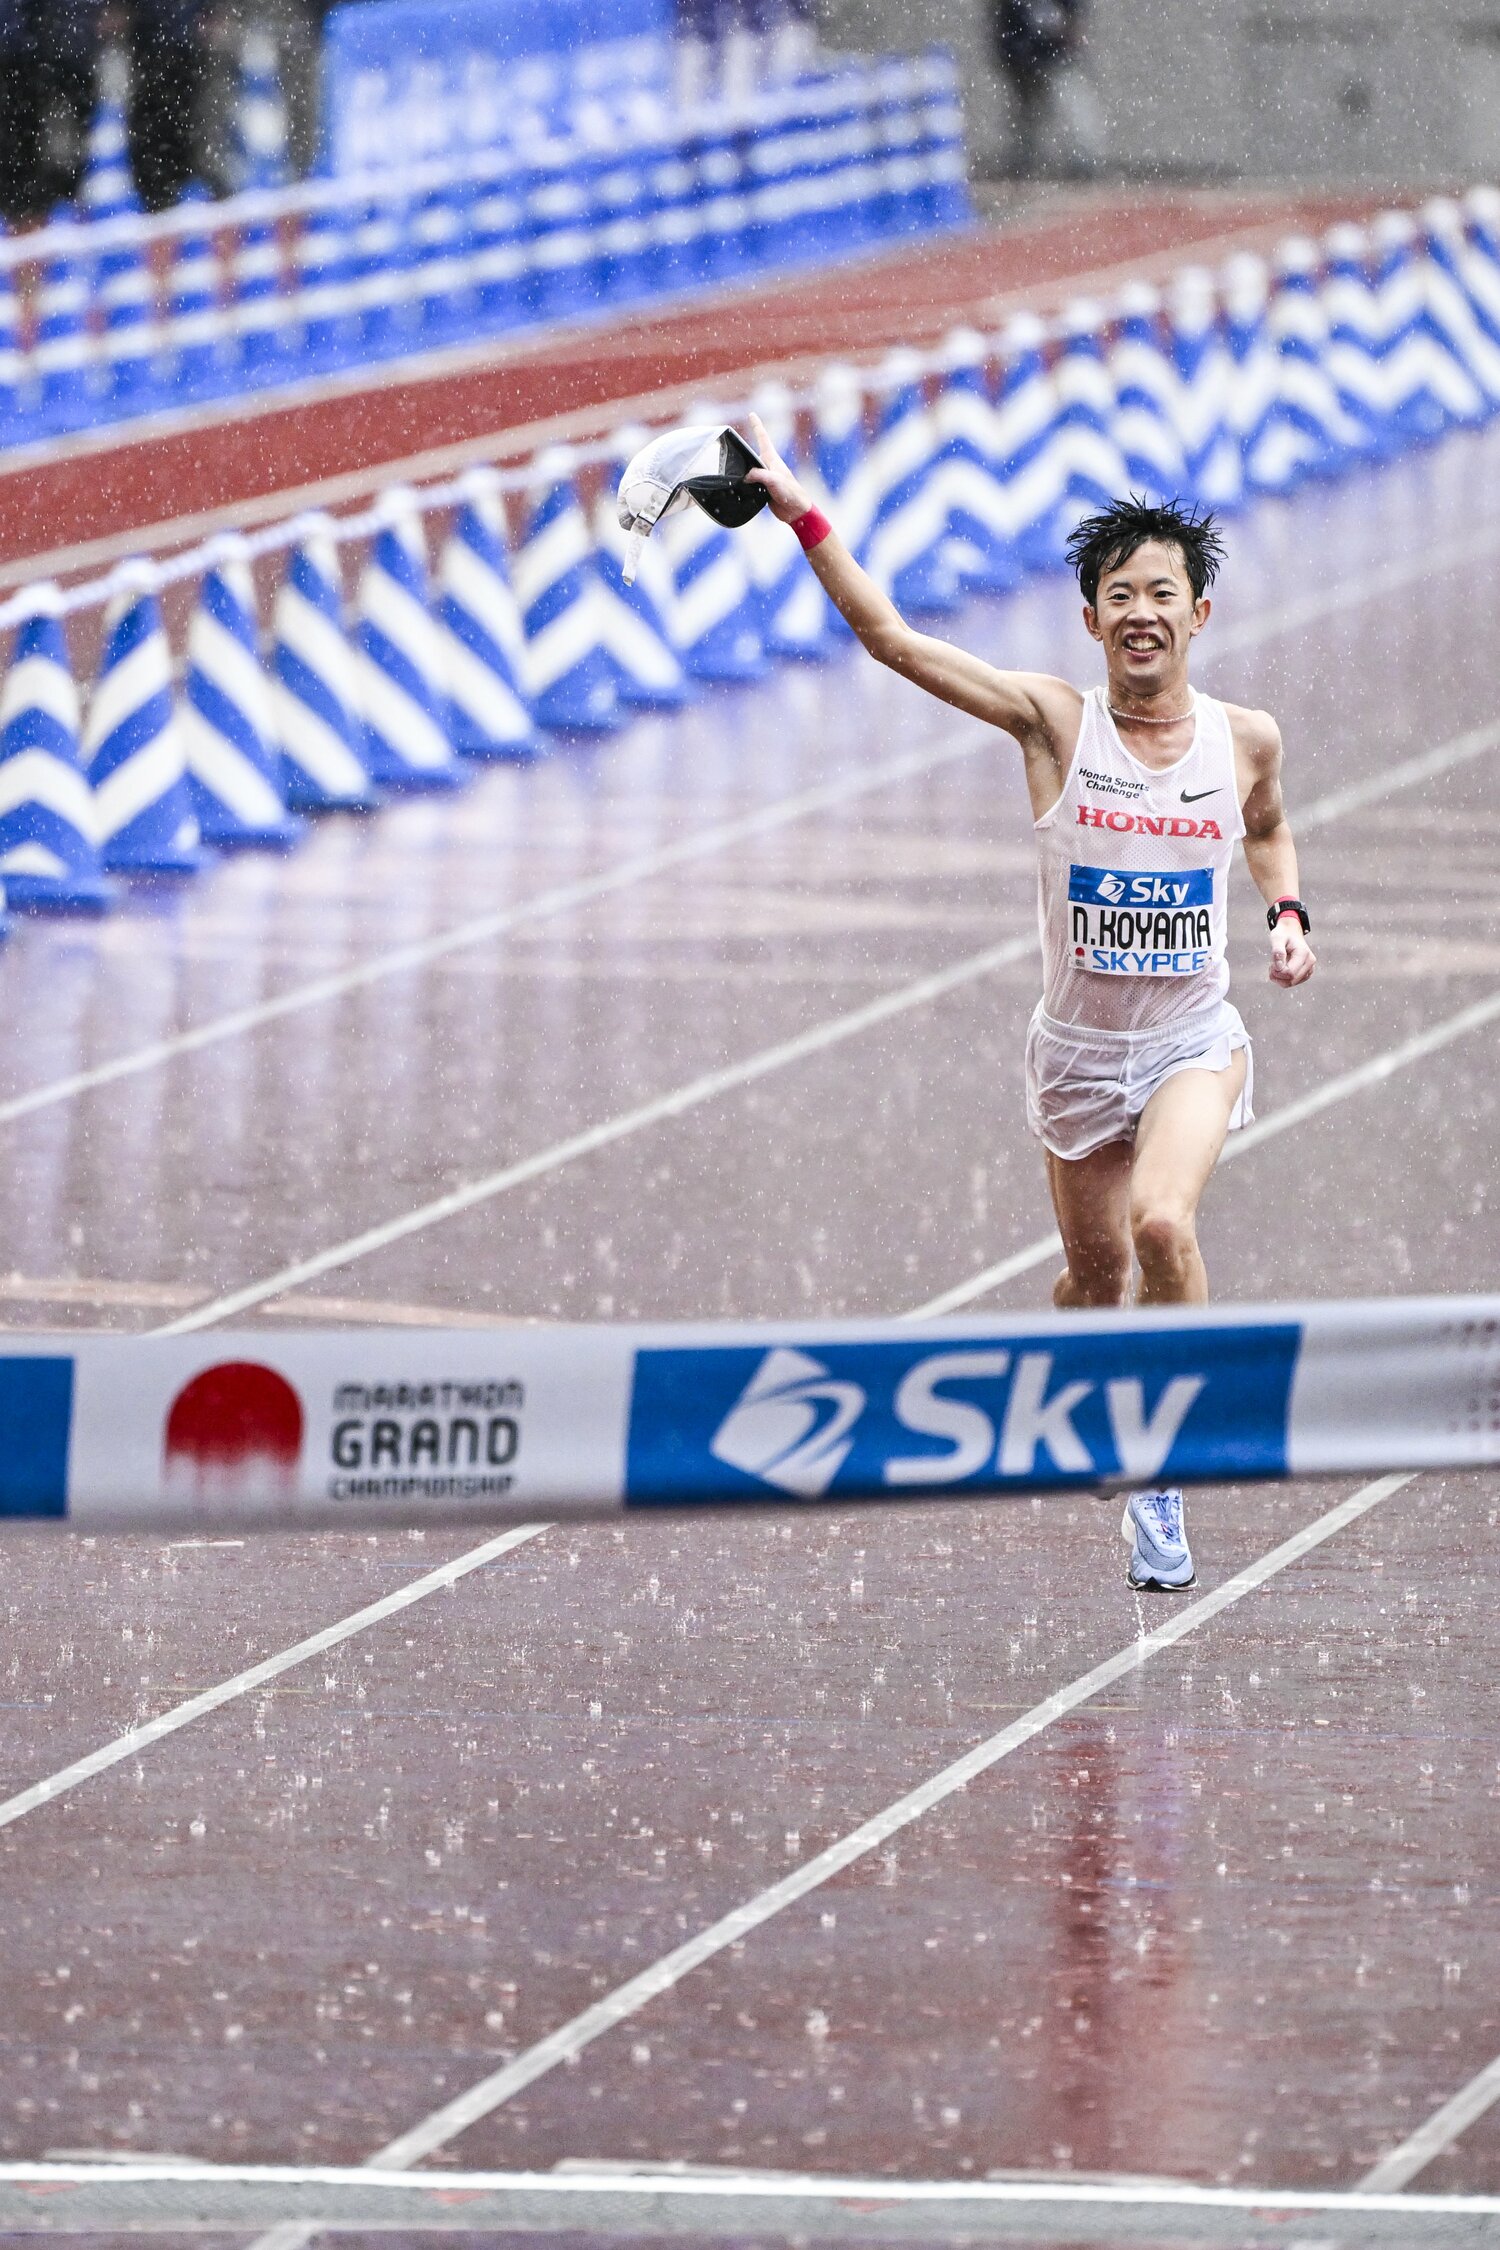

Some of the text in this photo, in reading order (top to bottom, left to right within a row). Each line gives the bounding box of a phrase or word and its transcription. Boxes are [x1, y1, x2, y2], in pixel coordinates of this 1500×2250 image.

[1078, 768, 1150, 792] Honda Sports
[1086, 780, 1140, 799] Challenge
[1076, 804, 1223, 840] HONDA
[1130, 878, 1190, 906] Sky
[1073, 906, 1211, 949] N.KOYAMA
[1092, 950, 1208, 973] SKYPCE
[883, 1348, 1207, 1487] Sky
[332, 1417, 519, 1469] GRAND
